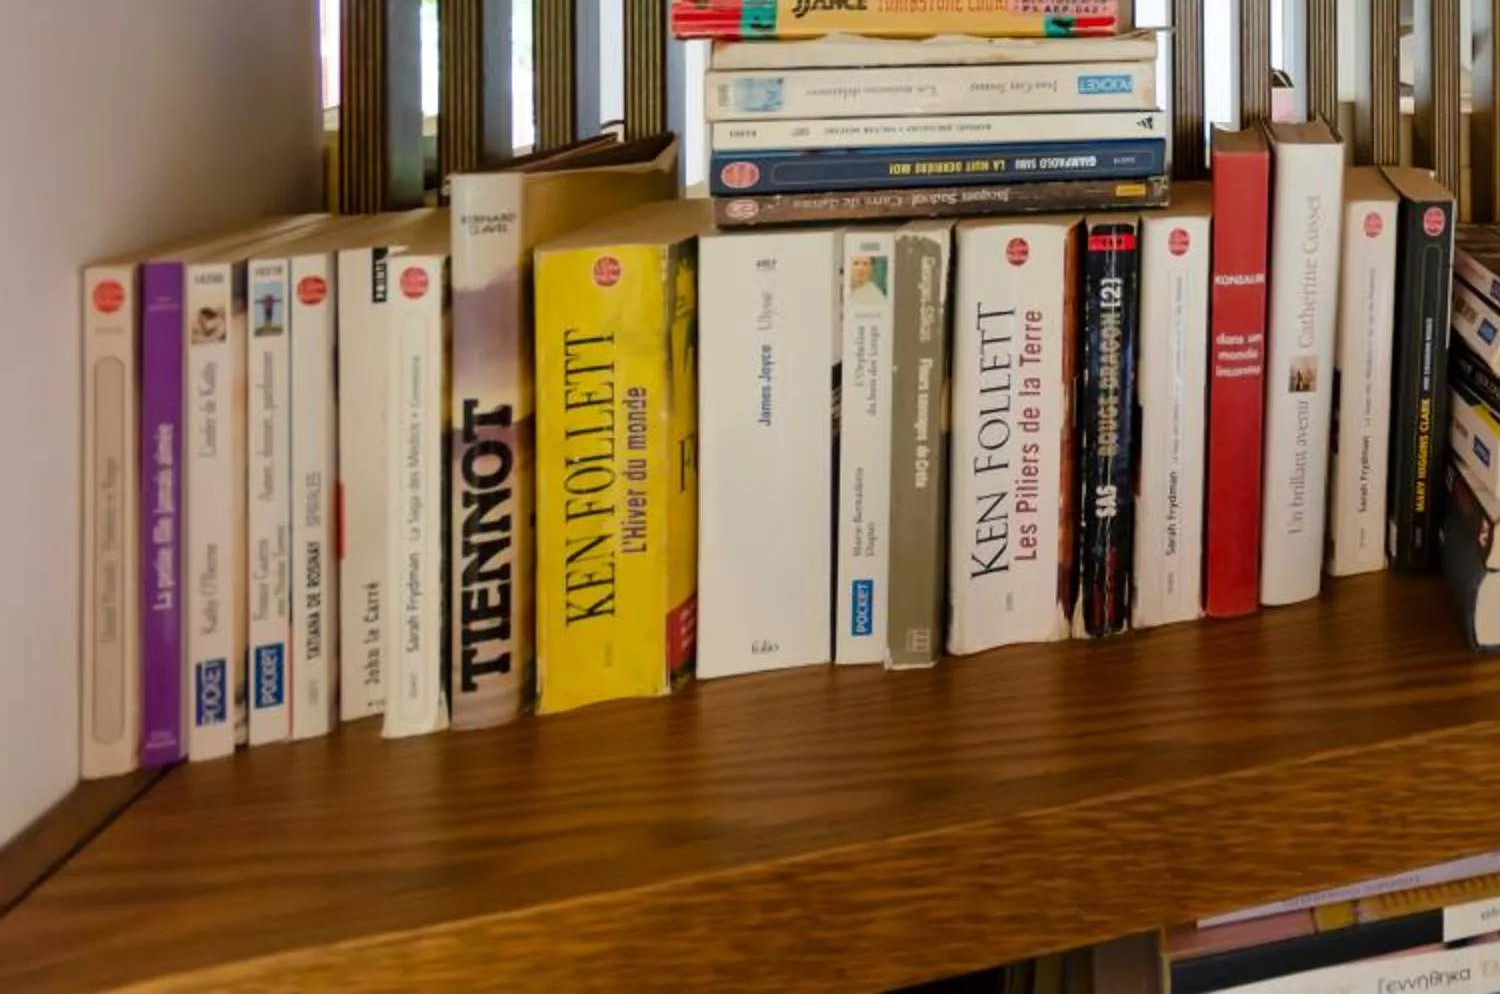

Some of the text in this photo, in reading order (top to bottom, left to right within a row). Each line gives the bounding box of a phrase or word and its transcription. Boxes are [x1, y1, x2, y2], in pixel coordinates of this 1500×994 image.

[964, 161, 989, 173] NUIT
[993, 160, 1006, 172] LA
[1297, 194, 1323, 350] Catherine Cusset
[757, 344, 775, 383] Joyce
[757, 385, 773, 427] James
[1418, 398, 1431, 432] CLARK
[970, 302, 1016, 580] KEN FOLLETT
[1014, 309, 1042, 562] Les Piliers de la Terre
[1417, 434, 1429, 479] HIGGINS
[564, 329, 616, 627] KEN FOLLETT
[621, 386, 648, 555] L'Hiver du monde
[1289, 448, 1308, 508] brillant
[1096, 484, 1117, 519] SAS
[1166, 471, 1180, 521] Frydman
[1415, 481, 1427, 513] MARY
[461, 398, 513, 693] TIENNOT
[1165, 523, 1177, 557] Sarah
[306, 591, 322, 608] DE
[406, 551, 422, 654] Sarah Frydman
[856, 583, 869, 634] POCKET
[363, 628, 380, 644] le
[258, 646, 282, 705] POCKET
[363, 647, 380, 687] John
